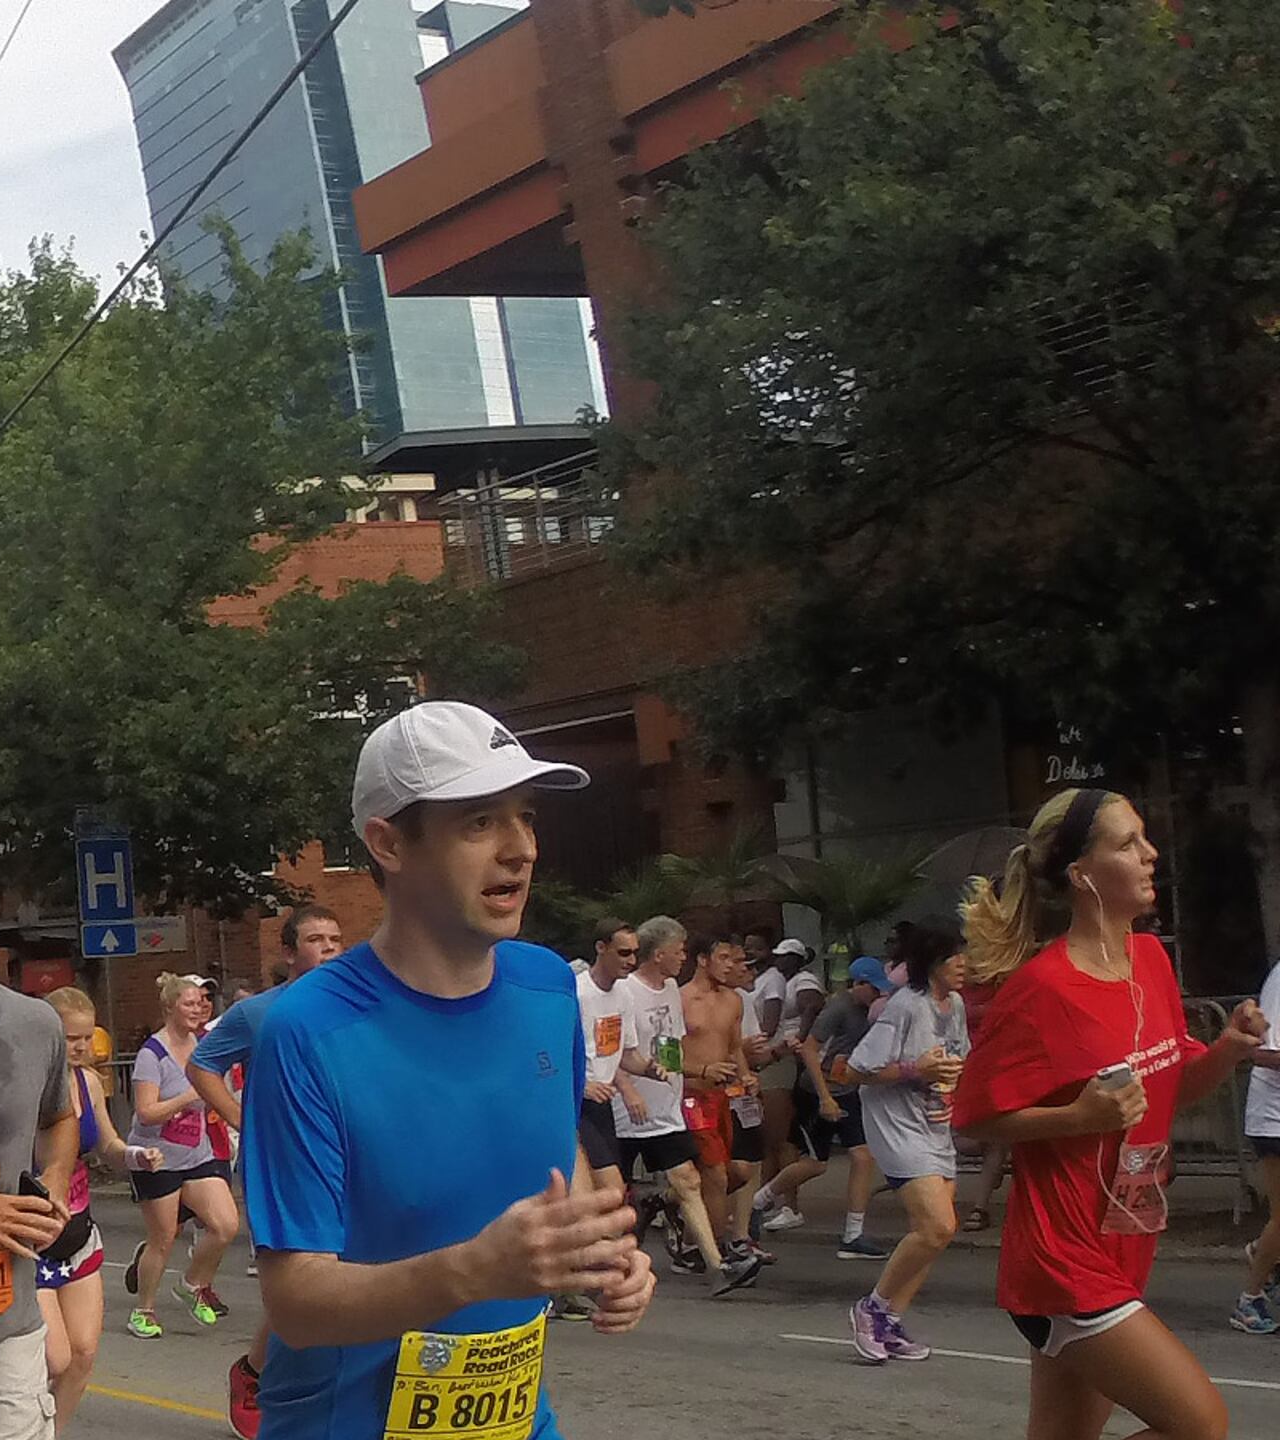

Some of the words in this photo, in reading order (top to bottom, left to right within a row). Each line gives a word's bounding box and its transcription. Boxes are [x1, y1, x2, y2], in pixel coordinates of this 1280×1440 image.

[84, 852, 127, 910] H
[463, 1356, 509, 1375] Road
[509, 1344, 539, 1370] Race
[466, 1328, 540, 1361] Peachtree
[407, 1393, 440, 1430] B
[450, 1382, 530, 1429] 8015
